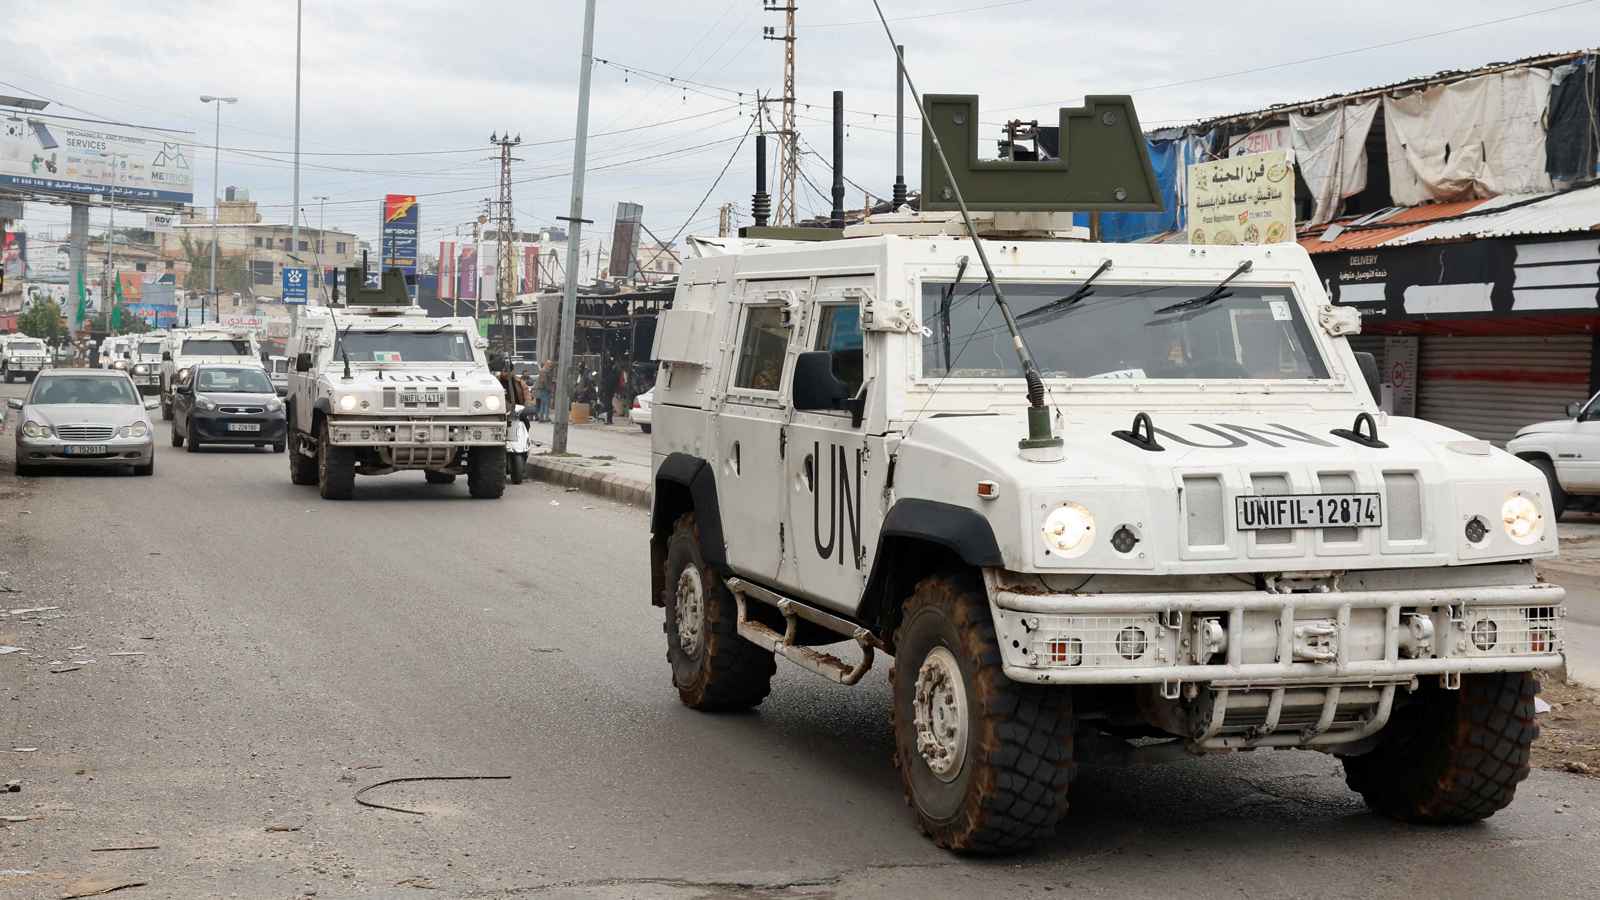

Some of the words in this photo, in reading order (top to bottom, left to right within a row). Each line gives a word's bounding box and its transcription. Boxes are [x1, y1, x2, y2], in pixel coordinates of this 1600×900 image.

[66, 138, 106, 151] SERVICES
[1212, 165, 1244, 187] المحبة
[1246, 158, 1265, 183] فرن
[1253, 185, 1282, 205] مناقيش
[1350, 255, 1378, 266] DELIVERY
[1140, 423, 1341, 448] UN
[814, 441, 861, 570] UN
[1243, 498, 1375, 525] UNIFIL-12874
